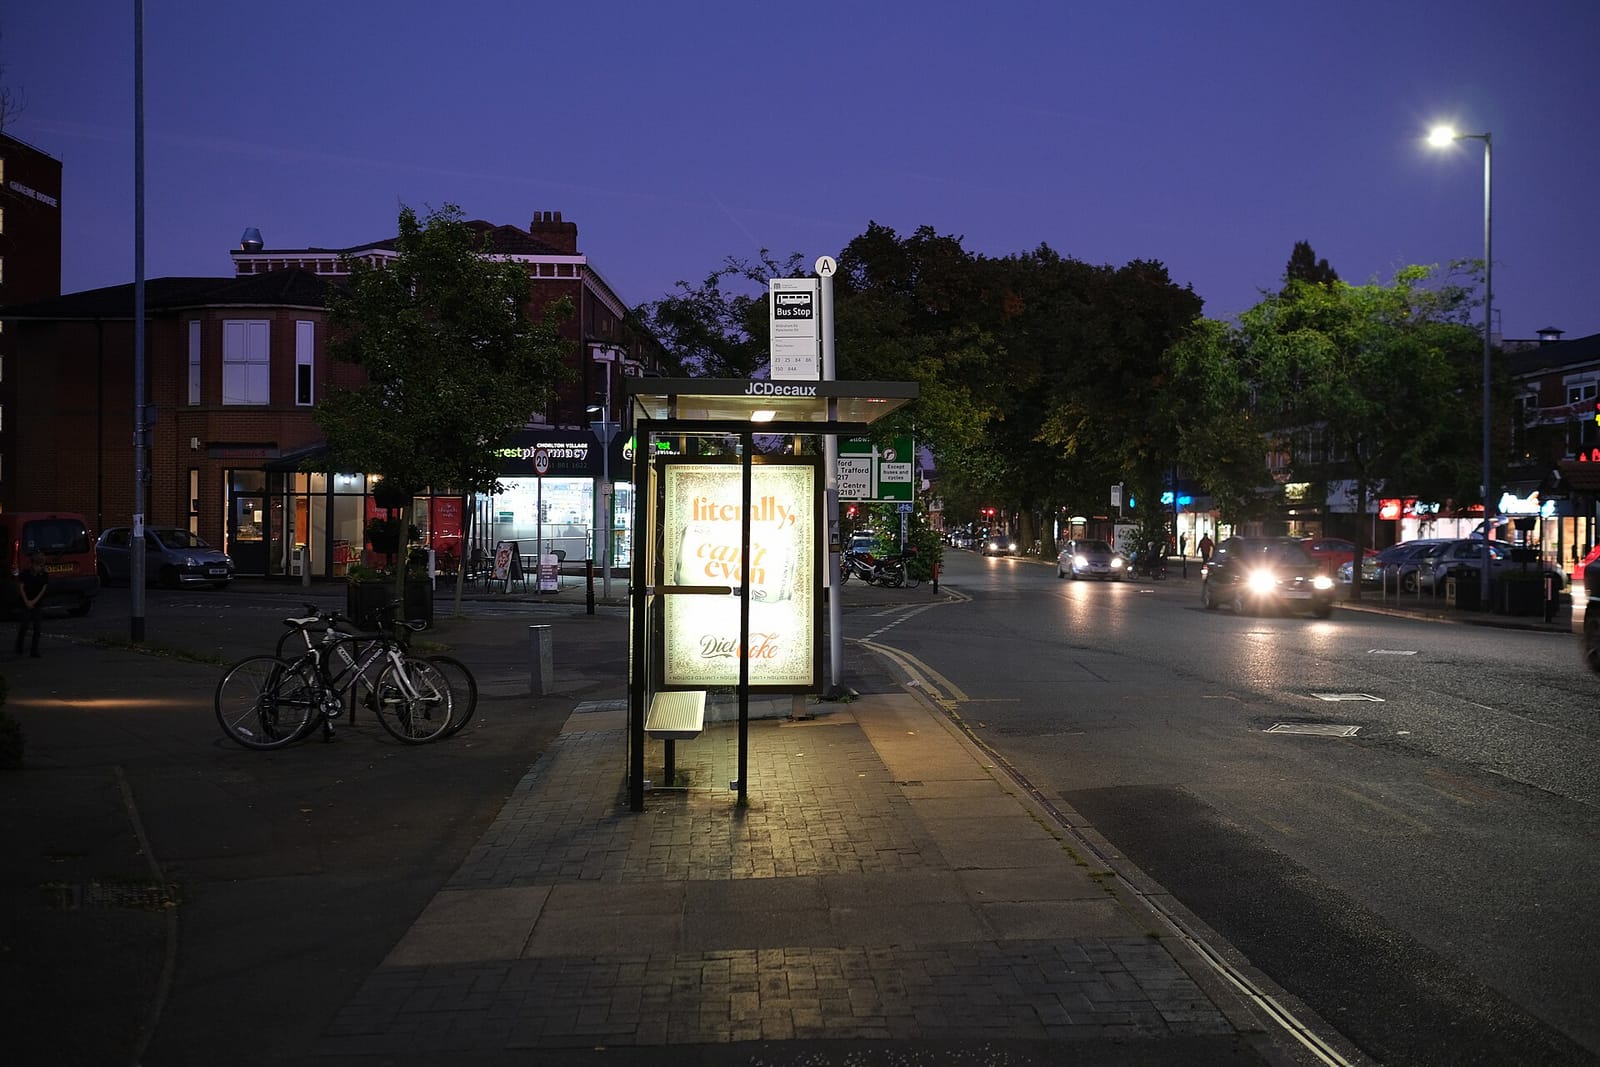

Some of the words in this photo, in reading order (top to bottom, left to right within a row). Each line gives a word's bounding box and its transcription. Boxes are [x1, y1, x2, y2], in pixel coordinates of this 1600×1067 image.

[820, 259, 832, 273] A
[776, 307, 792, 317] Bus
[792, 306, 811, 318] Stop
[744, 382, 817, 396] JCDecaux
[536, 442, 565, 450] CHORLTON
[565, 442, 588, 450] VILLAGE
[536, 455, 548, 468] 20
[841, 466, 869, 474] Trafford
[699, 633, 737, 659] Diet
